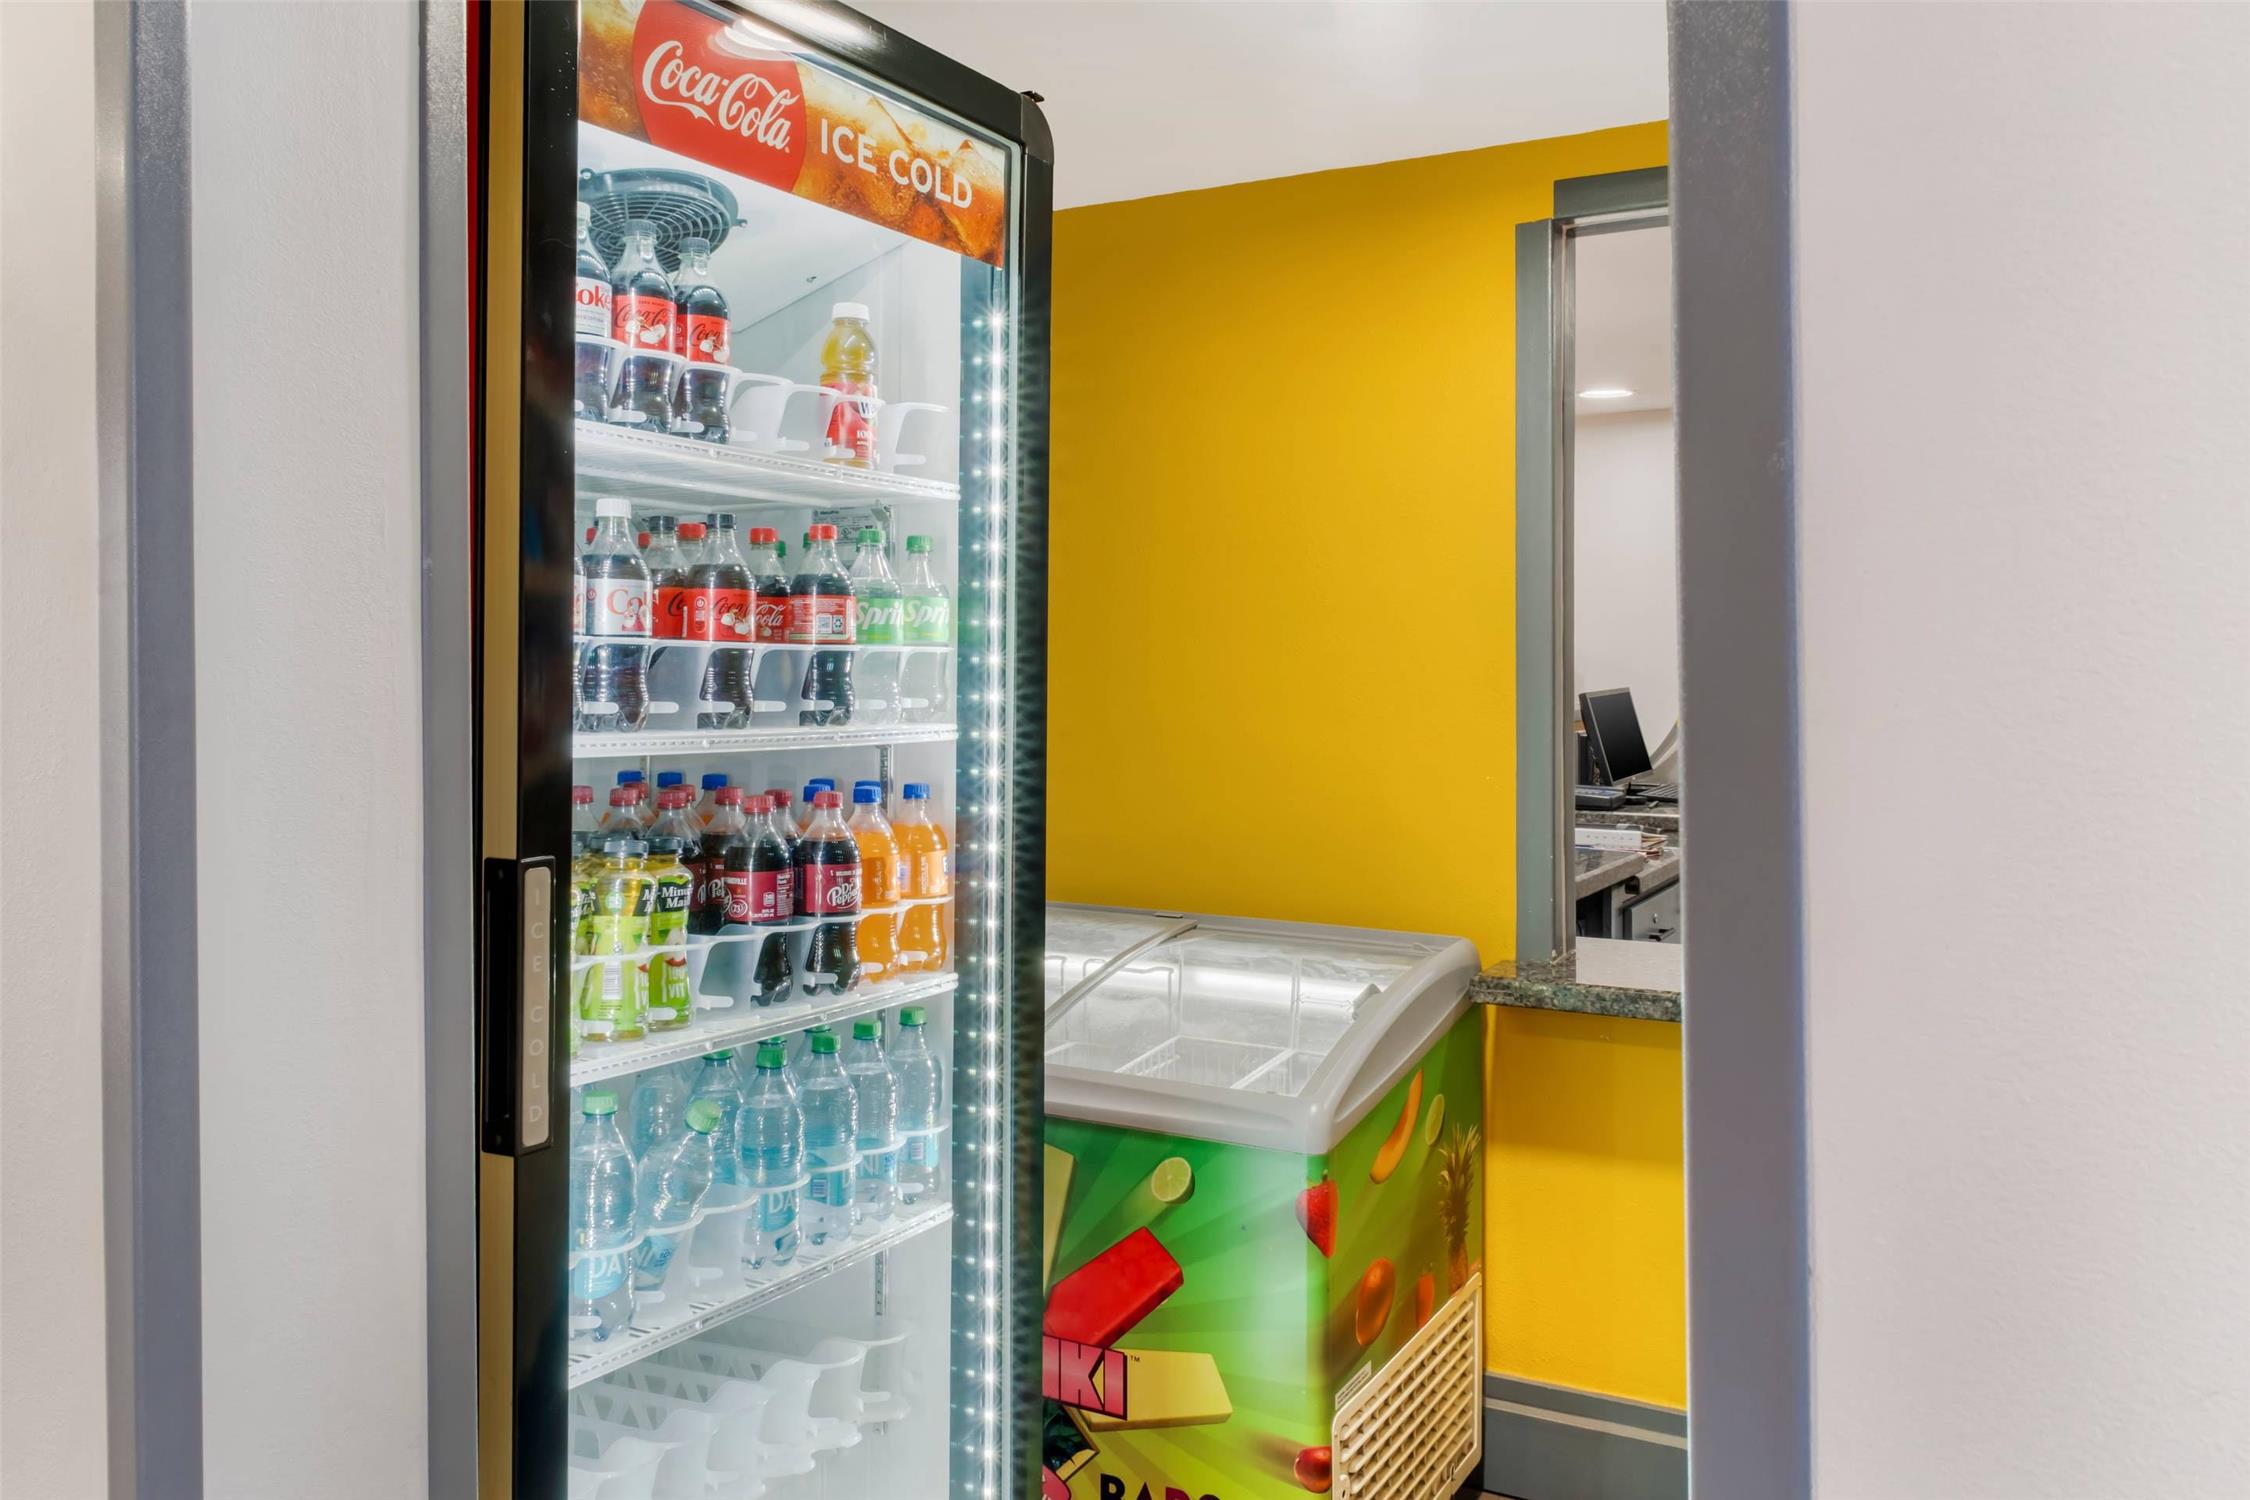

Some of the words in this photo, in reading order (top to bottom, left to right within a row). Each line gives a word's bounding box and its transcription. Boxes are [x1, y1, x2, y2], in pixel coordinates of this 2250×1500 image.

[642, 40, 800, 153] Coca-Cola
[821, 118, 877, 174] ICE
[888, 149, 973, 208] COLD
[531, 888, 544, 973] ICE
[529, 1005, 544, 1122] COLD
